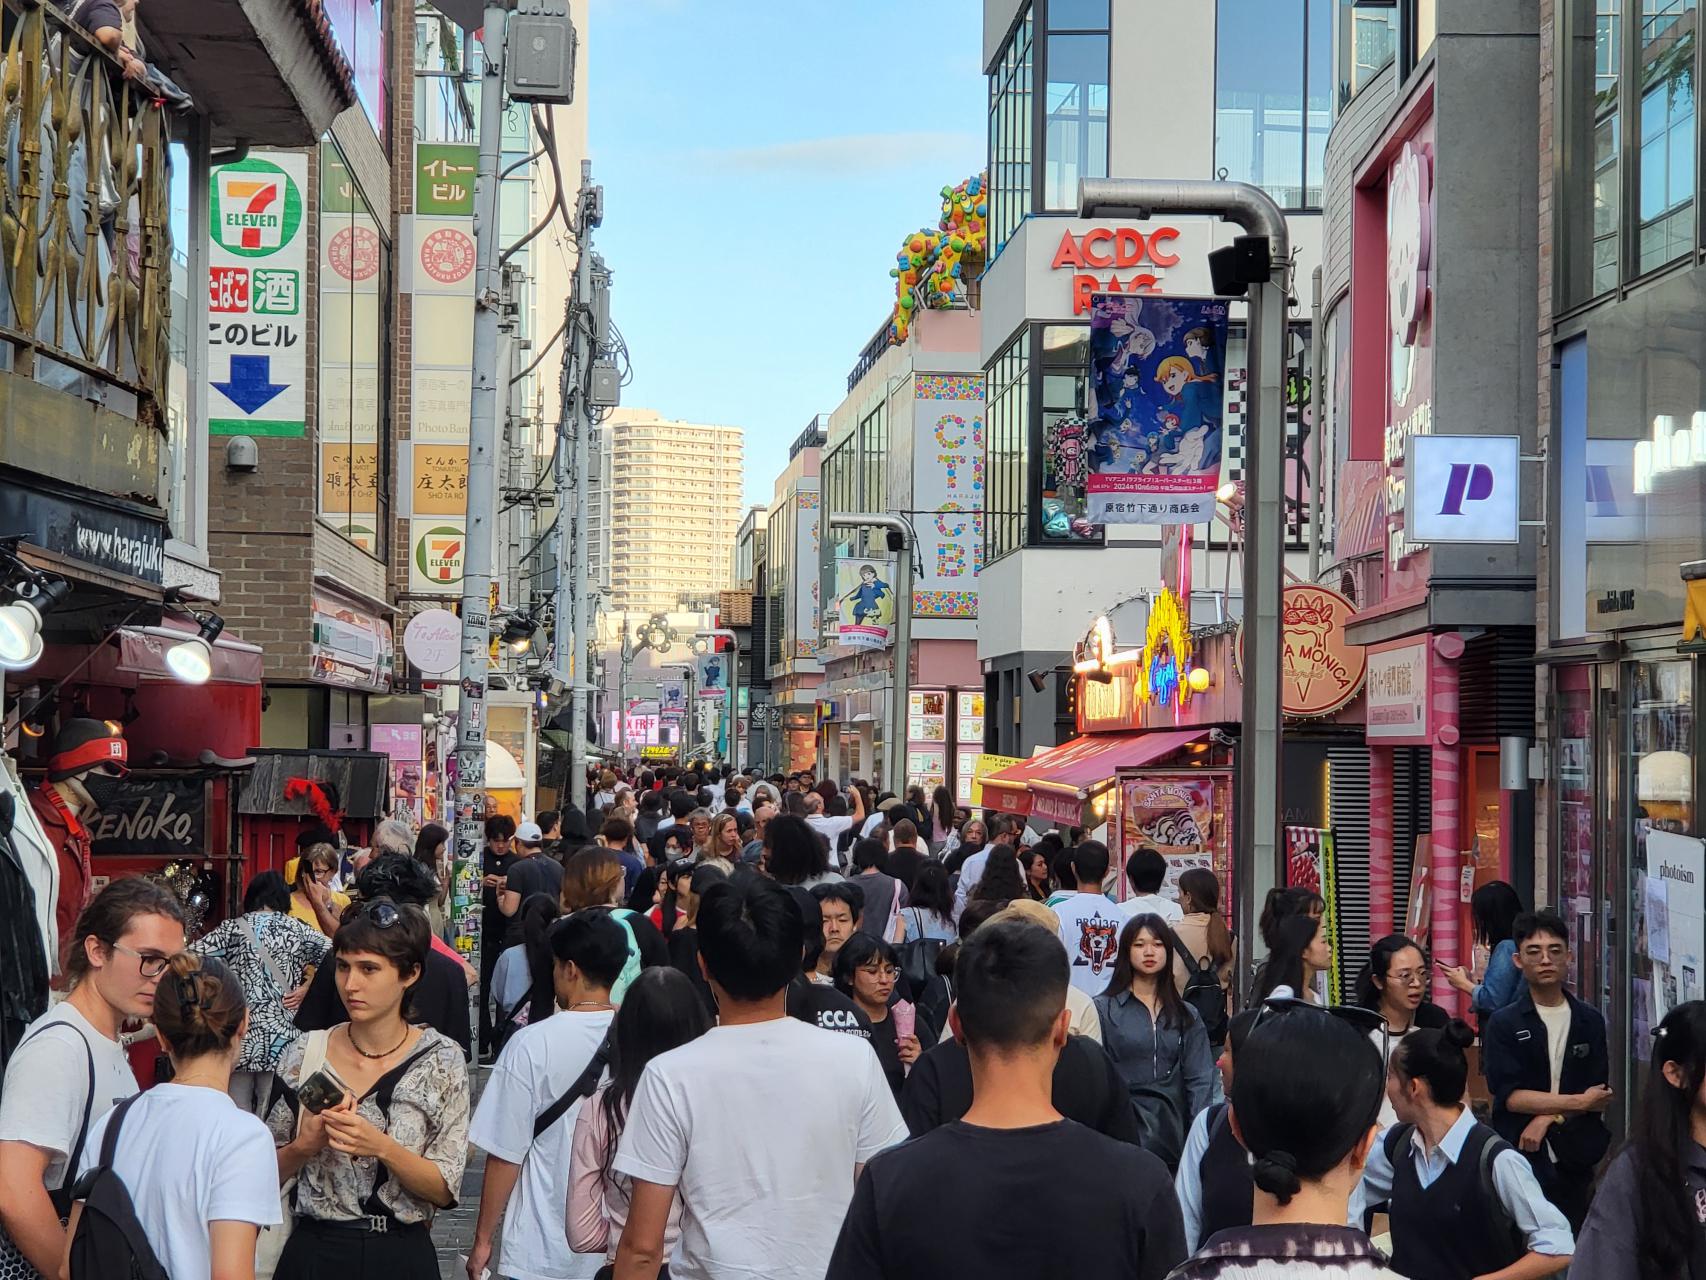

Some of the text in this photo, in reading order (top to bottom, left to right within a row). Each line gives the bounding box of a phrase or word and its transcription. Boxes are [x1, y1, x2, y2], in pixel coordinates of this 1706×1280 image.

[423, 159, 474, 178] イトー
[432, 184, 466, 201] ビル
[227, 181, 277, 248] 7
[1051, 227, 1181, 270] ACDC
[254, 271, 296, 311] 酒
[209, 322, 298, 348] このビル
[450, 423, 469, 434] Ban
[425, 456, 469, 465] とんかつ
[1435, 463, 1495, 516] P
[1105, 502, 1200, 514] 原宿竹下通り商店会
[1299, 645, 1351, 690] MONICA
[1659, 860, 1694, 884] photoism
